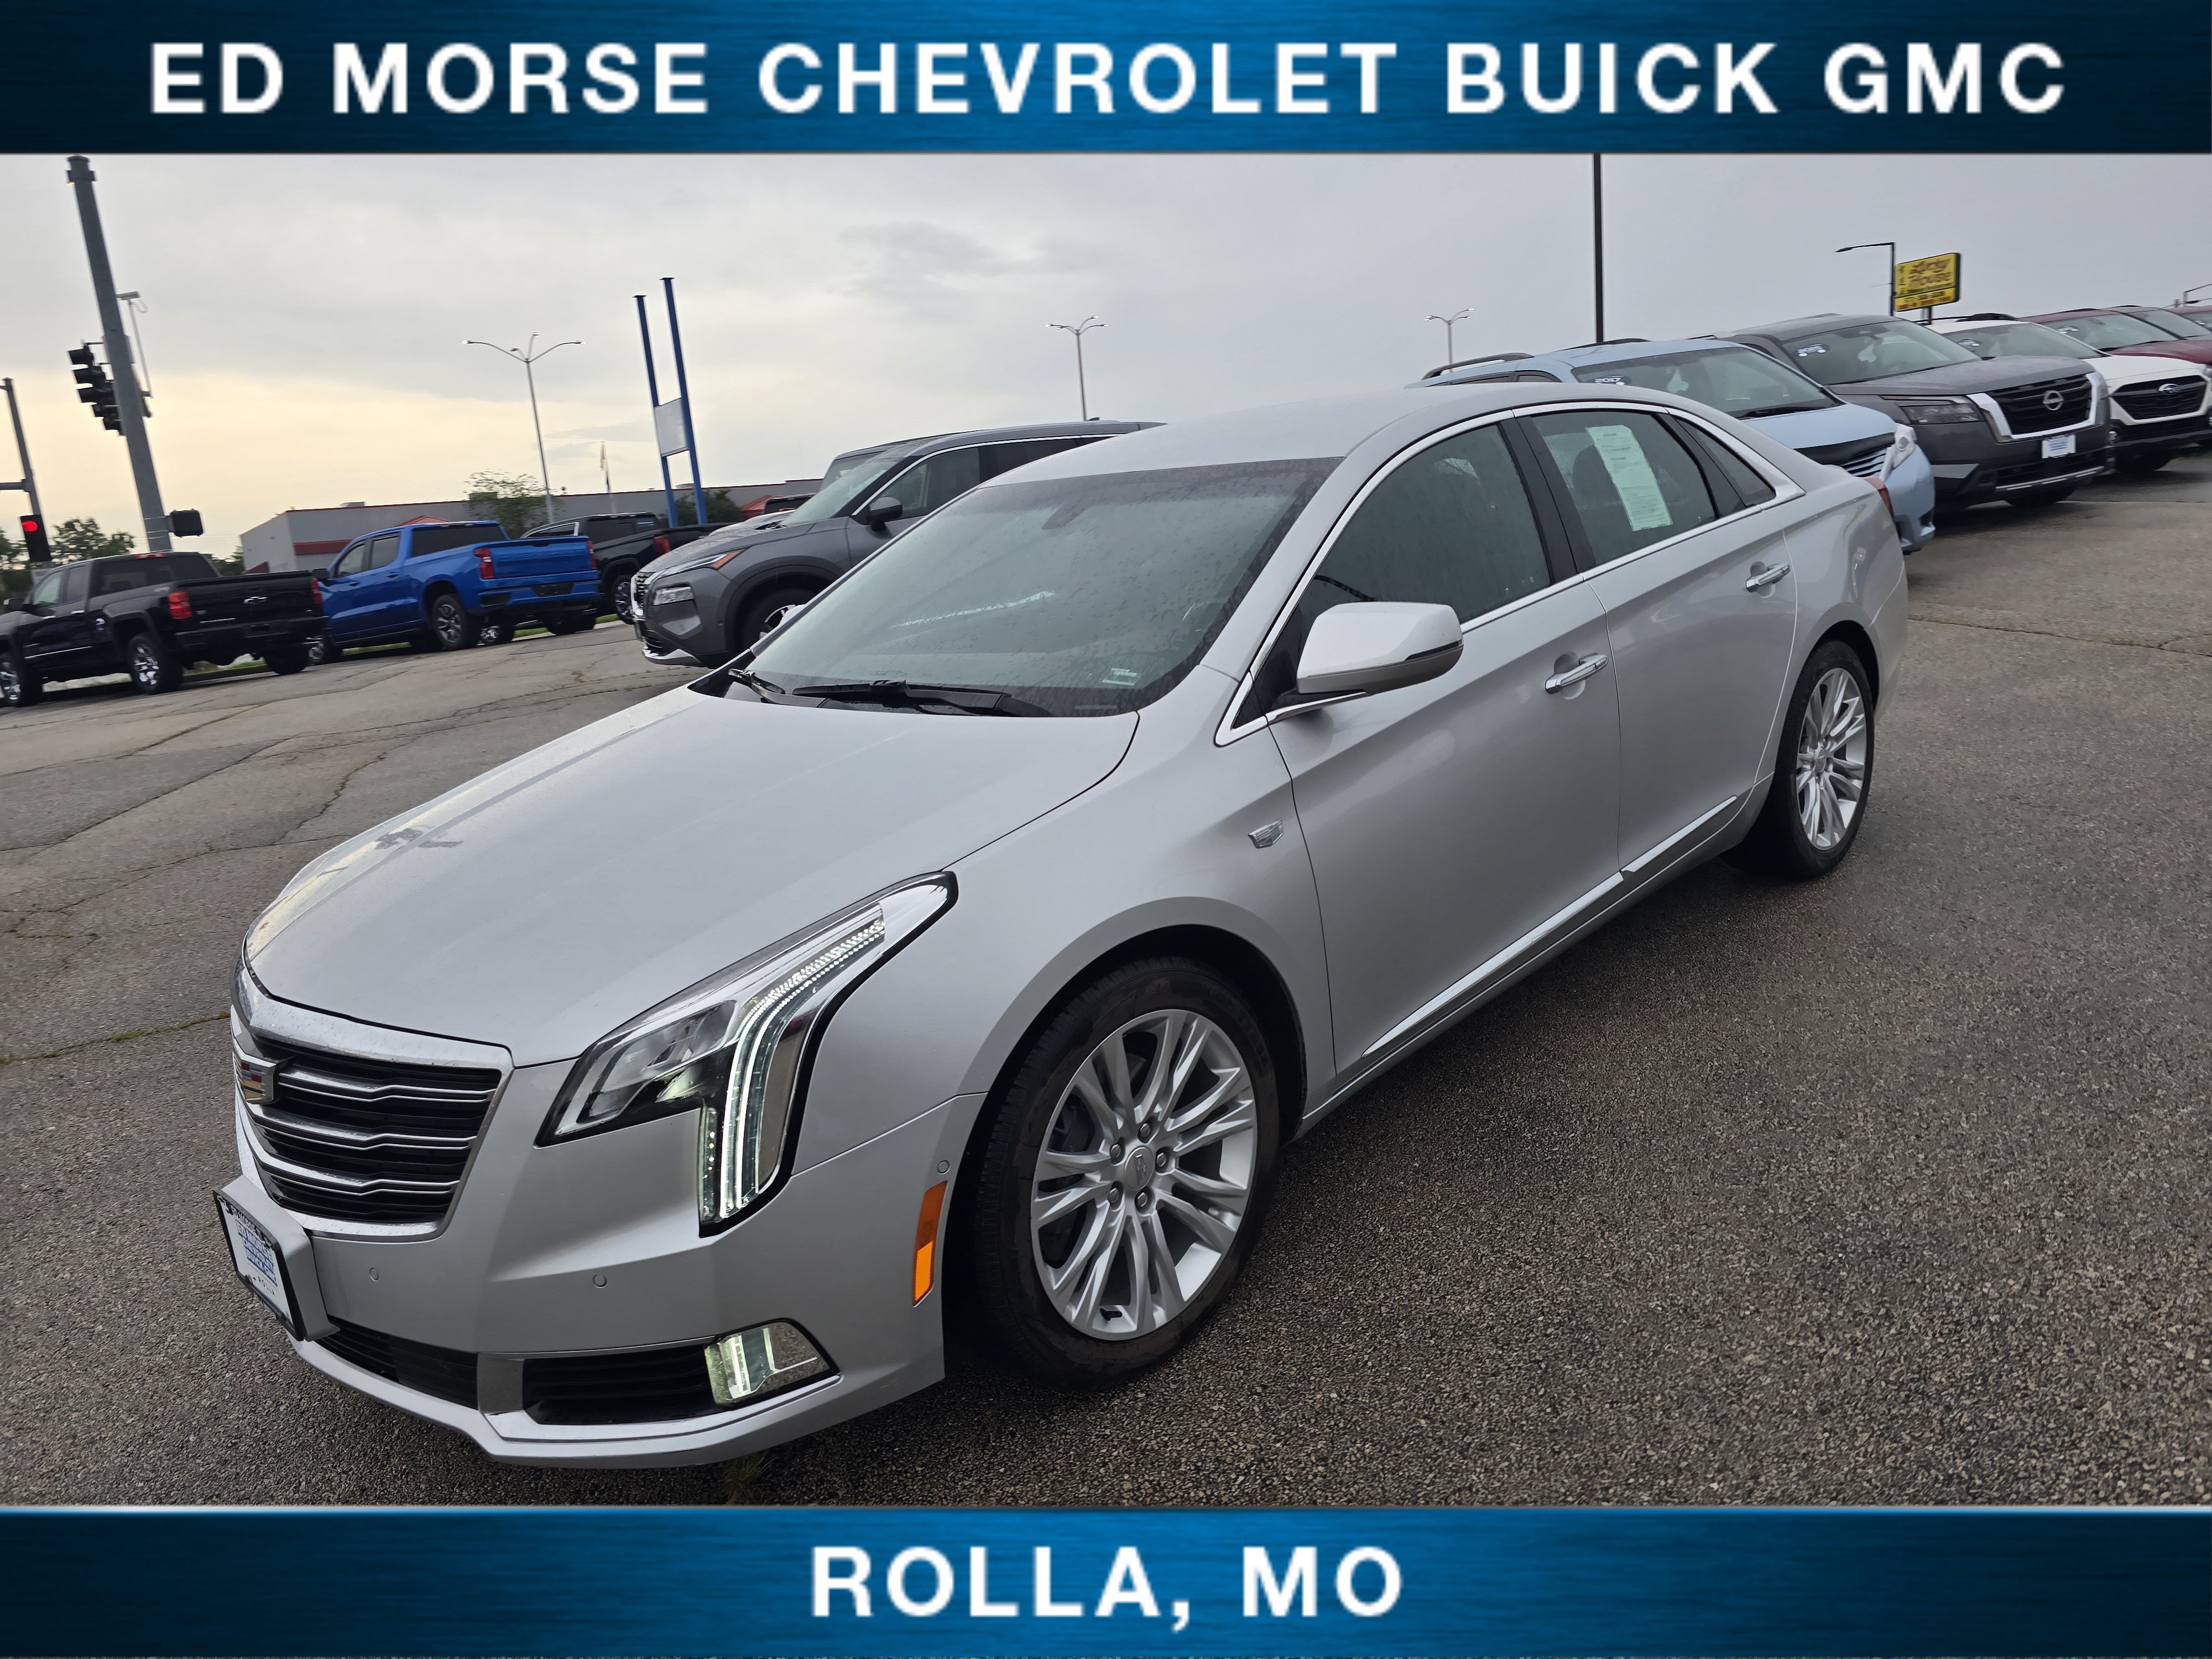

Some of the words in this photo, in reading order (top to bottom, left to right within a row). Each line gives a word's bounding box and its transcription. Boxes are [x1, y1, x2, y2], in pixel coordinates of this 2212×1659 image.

[237, 1224, 246, 1237] ED
[246, 1229, 274, 1262] MORSE
[258, 1275, 276, 1296] ROLLA
